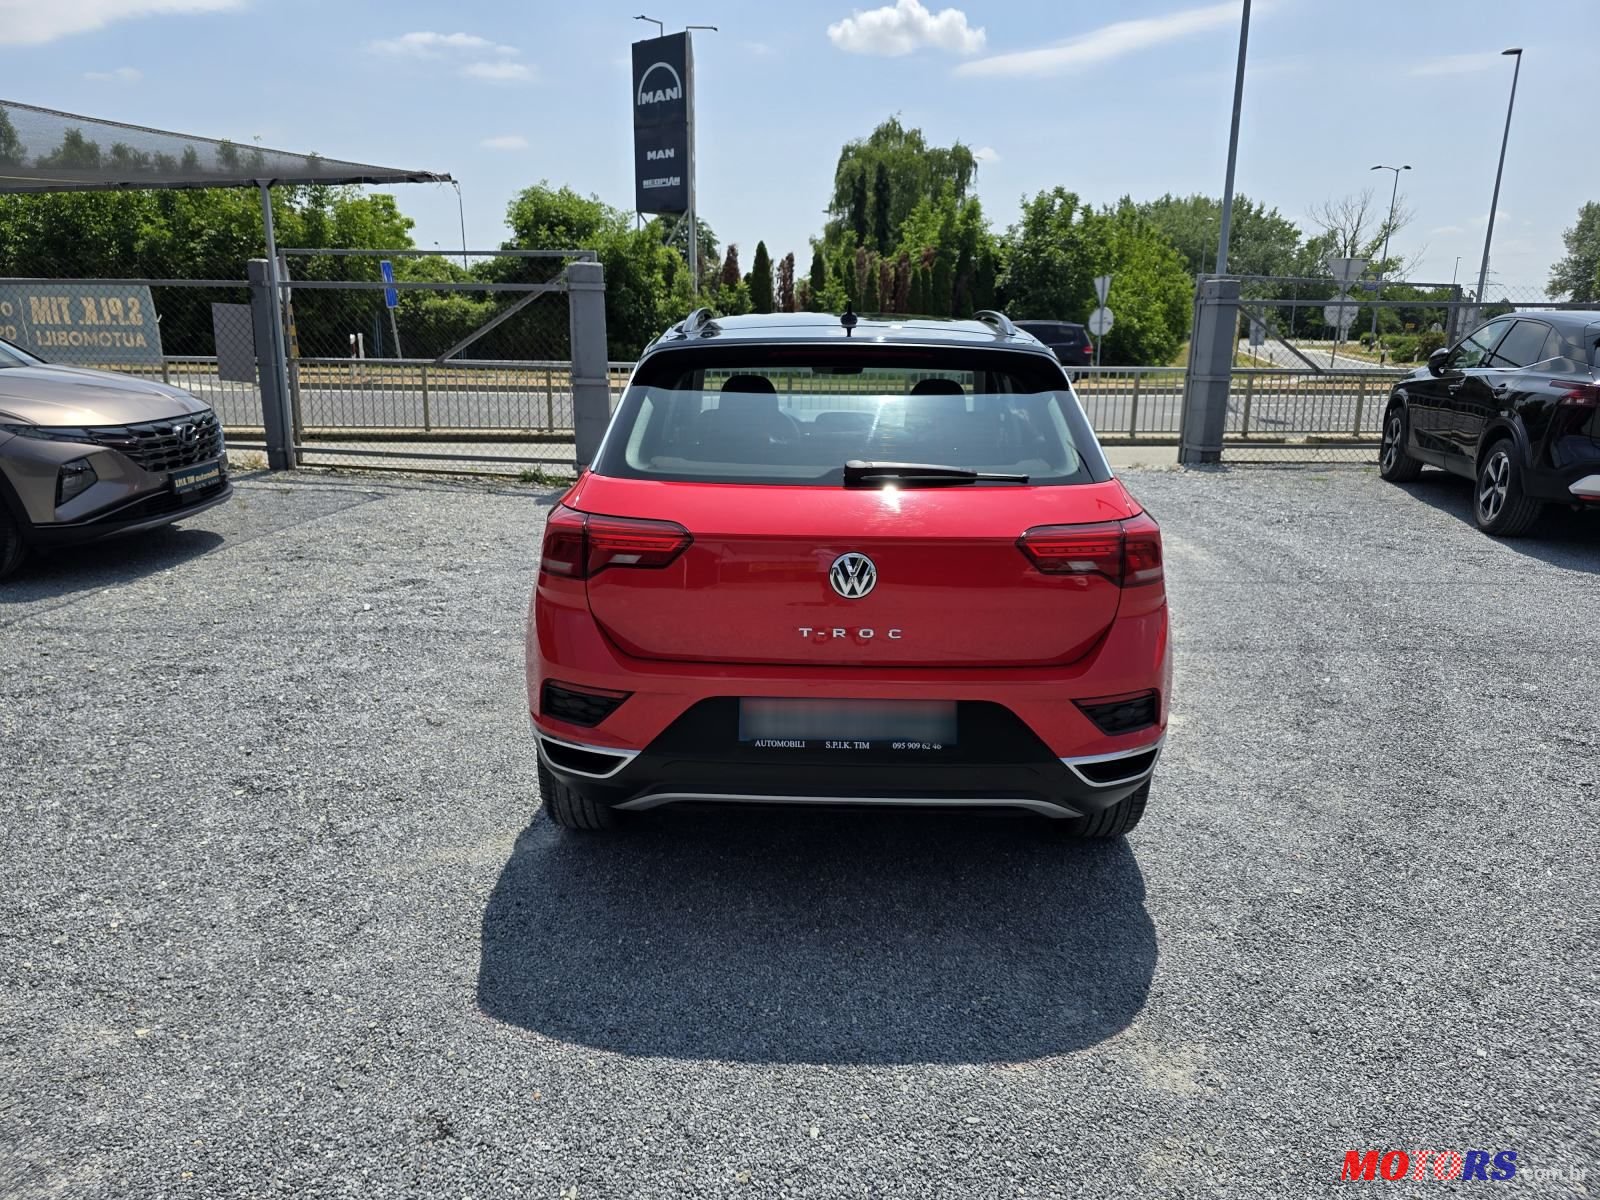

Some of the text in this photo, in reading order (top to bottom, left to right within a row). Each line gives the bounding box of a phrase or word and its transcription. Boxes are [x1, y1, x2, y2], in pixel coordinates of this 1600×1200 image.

[641, 87, 678, 105] MAN
[647, 148, 674, 160] MAN
[754, 739, 806, 748] AUTOMOBILI
[825, 741, 870, 750] S.P.I.K. TIM
[892, 741, 906, 750] 095
[906, 742, 921, 750] 909
